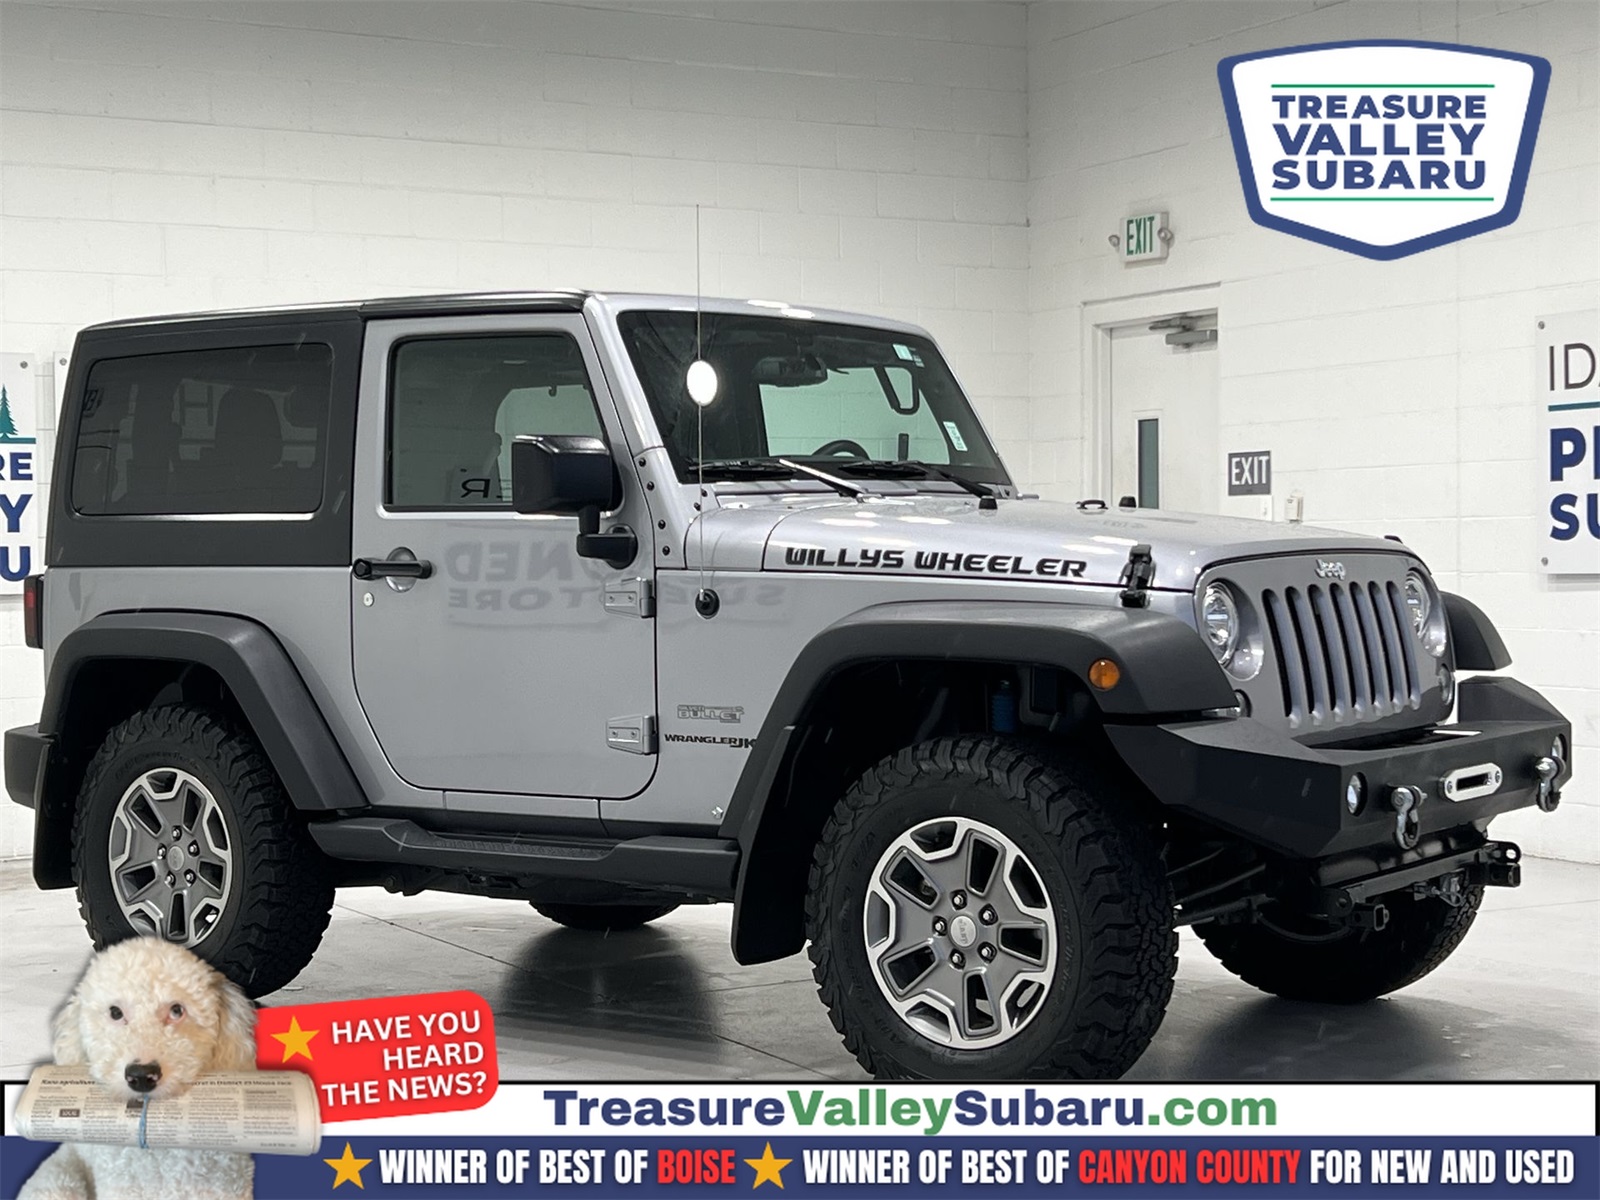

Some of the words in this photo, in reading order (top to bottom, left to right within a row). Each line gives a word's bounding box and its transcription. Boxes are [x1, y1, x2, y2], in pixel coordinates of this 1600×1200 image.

[1126, 216, 1155, 256] EXIT
[1549, 342, 1600, 391] ID
[0, 452, 33, 481] E
[1550, 426, 1600, 482] P
[1231, 455, 1269, 485] EXIT
[785, 547, 905, 568] WILLYS
[914, 551, 1088, 578] WHEELER
[1315, 559, 1345, 580] Jeep
[664, 734, 737, 745] WRANGLER
